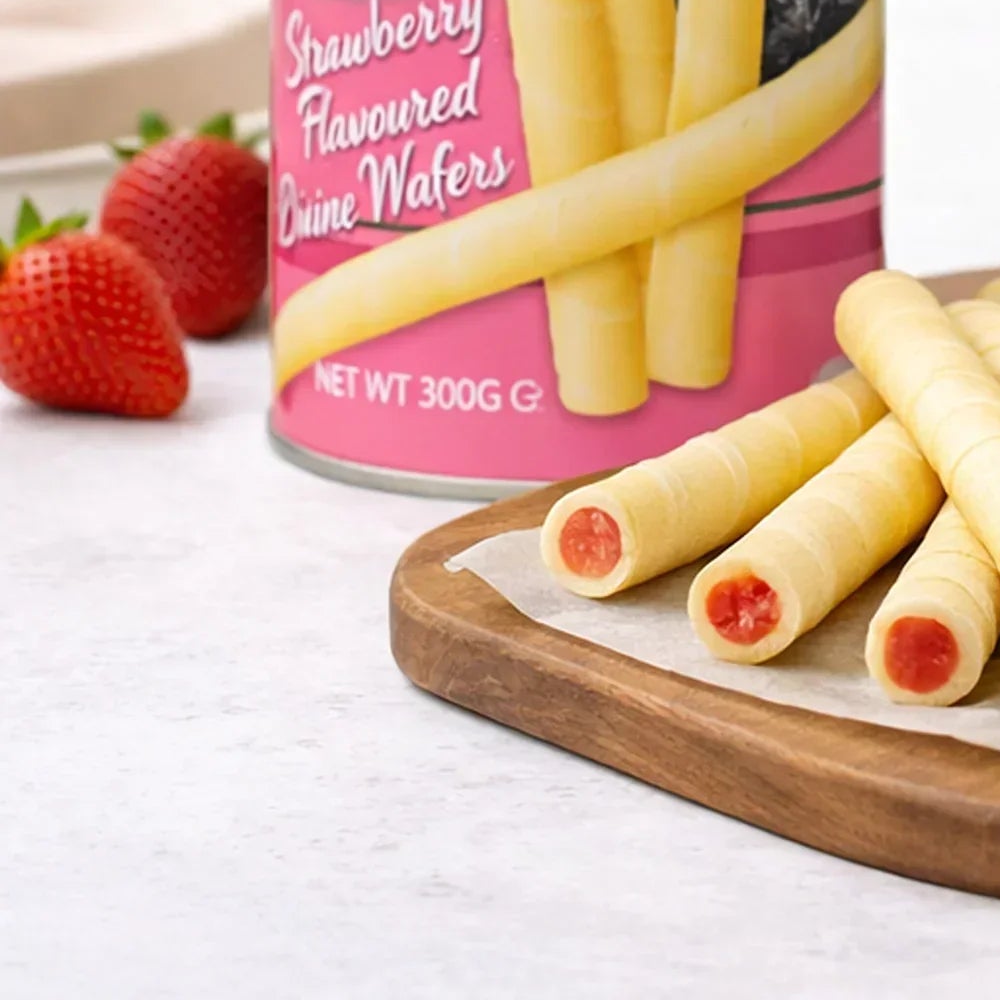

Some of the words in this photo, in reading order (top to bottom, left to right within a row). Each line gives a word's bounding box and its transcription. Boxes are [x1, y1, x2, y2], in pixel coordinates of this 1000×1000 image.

[296, 55, 482, 160] Flavoured
[357, 139, 516, 223] Wafers
[313, 358, 359, 399] NET
[363, 368, 412, 407] WT
[418, 375, 503, 413] 300G
